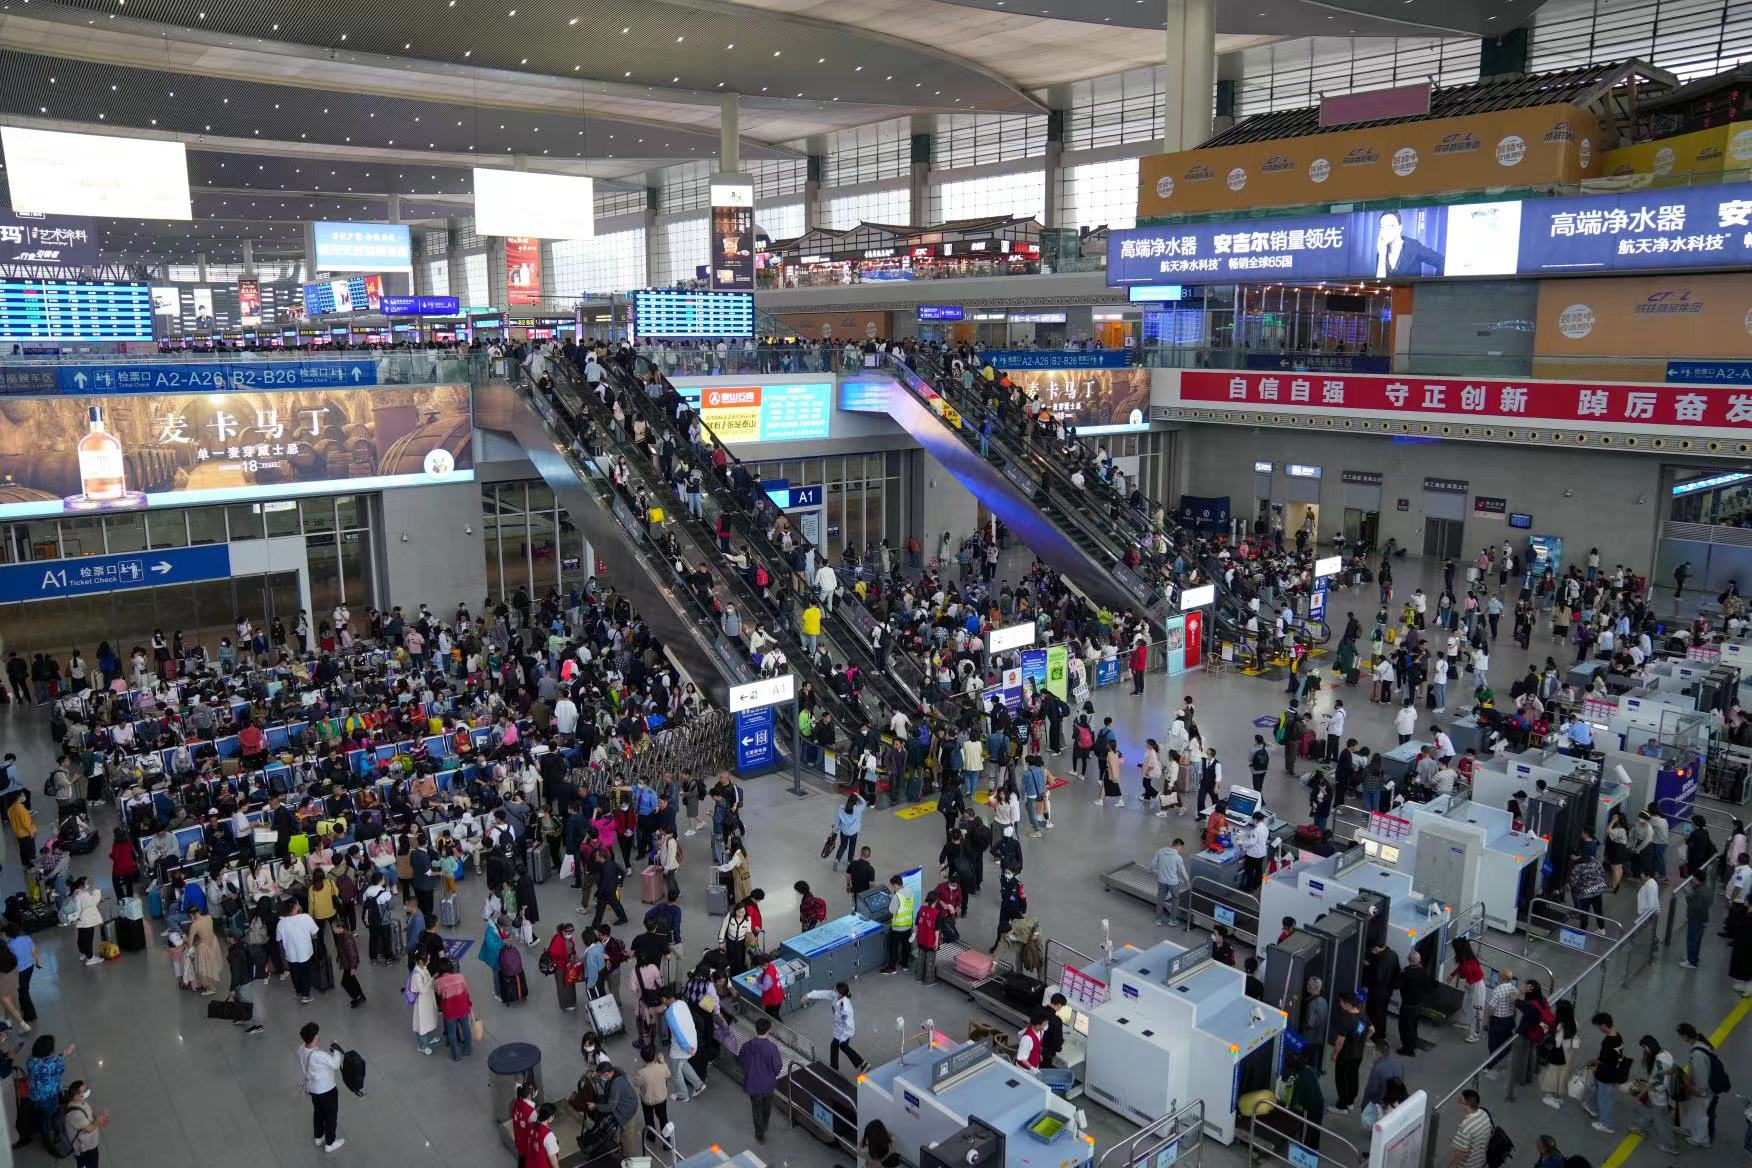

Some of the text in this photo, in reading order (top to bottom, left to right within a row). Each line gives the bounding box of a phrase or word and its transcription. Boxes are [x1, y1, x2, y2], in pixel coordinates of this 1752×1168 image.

[1551, 204, 1686, 237] 高端净水器
[39, 227, 87, 247] 艺术涂料
[1121, 228, 1343, 259] 高端净水器 安吉尔销量领先
[1618, 234, 1725, 255] 航天净水科技
[1160, 255, 1293, 272] 航天净水科技 畅销全球65国
[1181, 288, 1192, 298] B1
[1022, 356, 1048, 366] A2-A26
[1051, 356, 1077, 366] B2-B26
[118, 368, 328, 387] 检票口 A2-A26 B2-B26 检票口
[1229, 377, 1752, 423] 自信自强 守正创新 踔厉奋发
[156, 407, 330, 445] 麦卡马丁
[197, 443, 299, 460] 单一麦芽威士忌
[242, 460, 258, 472] 18
[799, 490, 813, 504] A1
[41, 565, 117, 589] A1 检票口
[69, 575, 118, 587] Ticket Check
